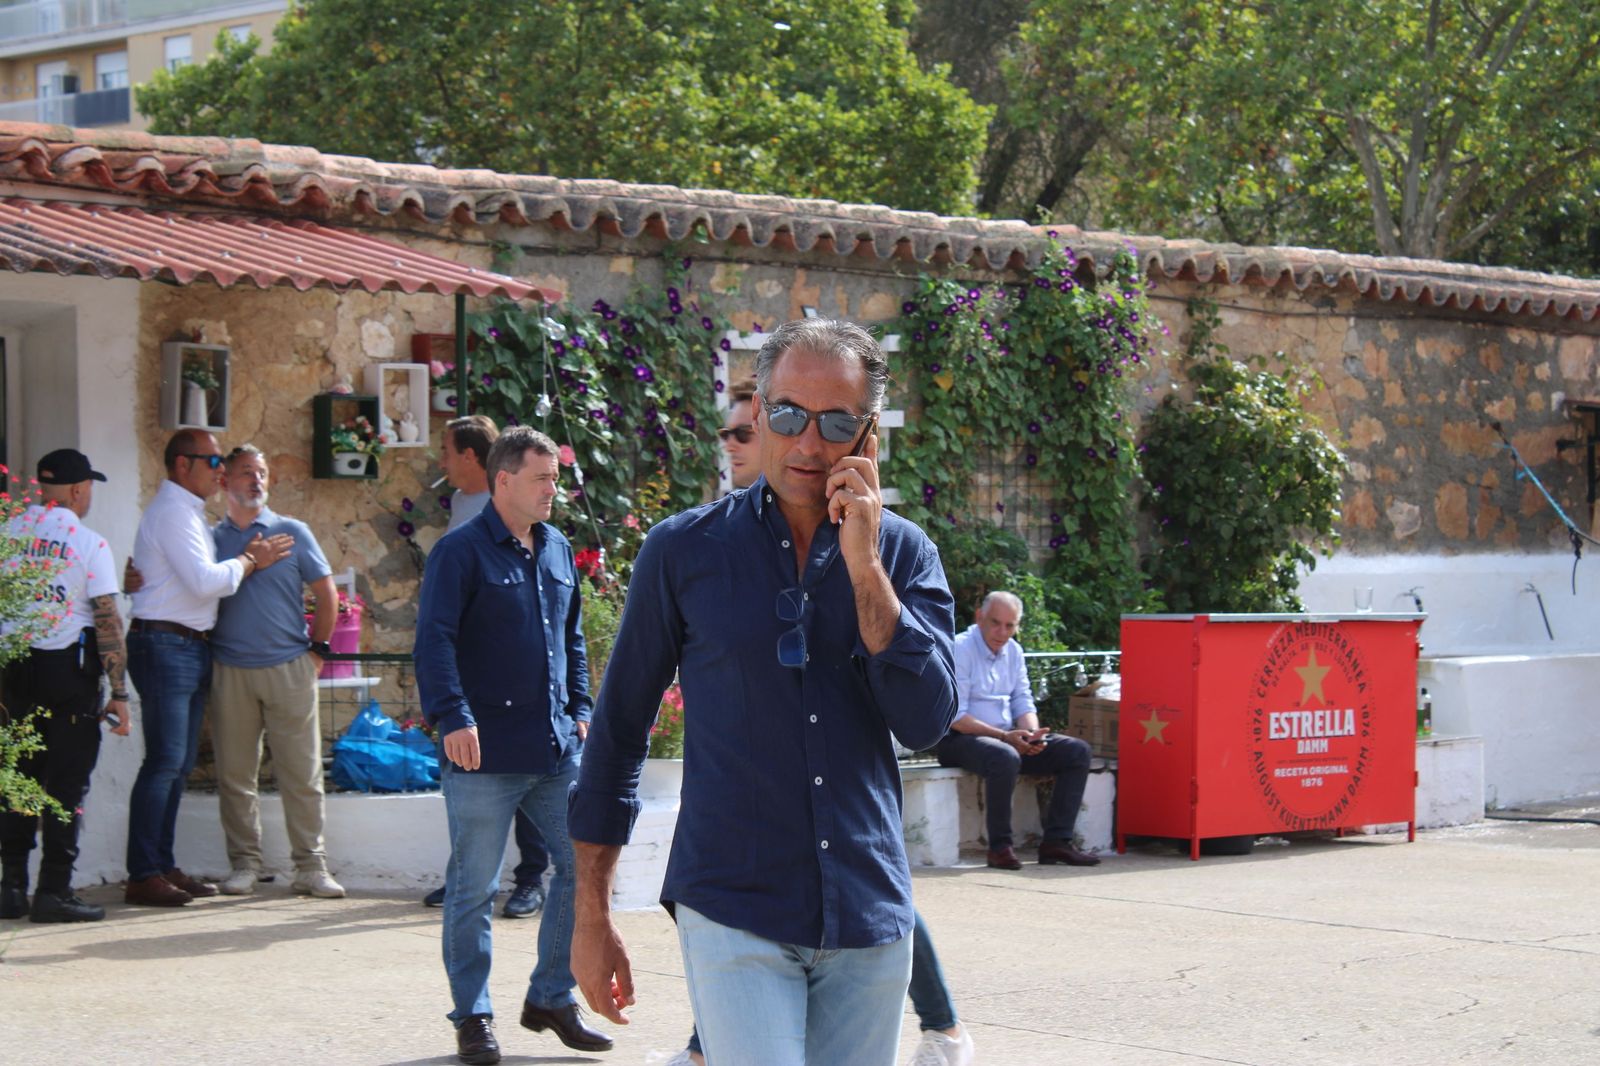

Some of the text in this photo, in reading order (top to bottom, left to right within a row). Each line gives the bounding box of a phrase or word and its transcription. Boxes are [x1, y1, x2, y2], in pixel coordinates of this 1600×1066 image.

[1256, 630, 1295, 698] CERVEZA
[1253, 708, 1263, 743] 1876
[1268, 708, 1356, 740] ESTRELLA
[1361, 704, 1371, 738] 1876
[1296, 739, 1329, 755] DAMM
[1273, 764, 1349, 778] RECETA ORIGINAL
[1301, 777, 1324, 788] 1876
[1253, 746, 1370, 831] AUGUST KUENTZMANN DAMM
